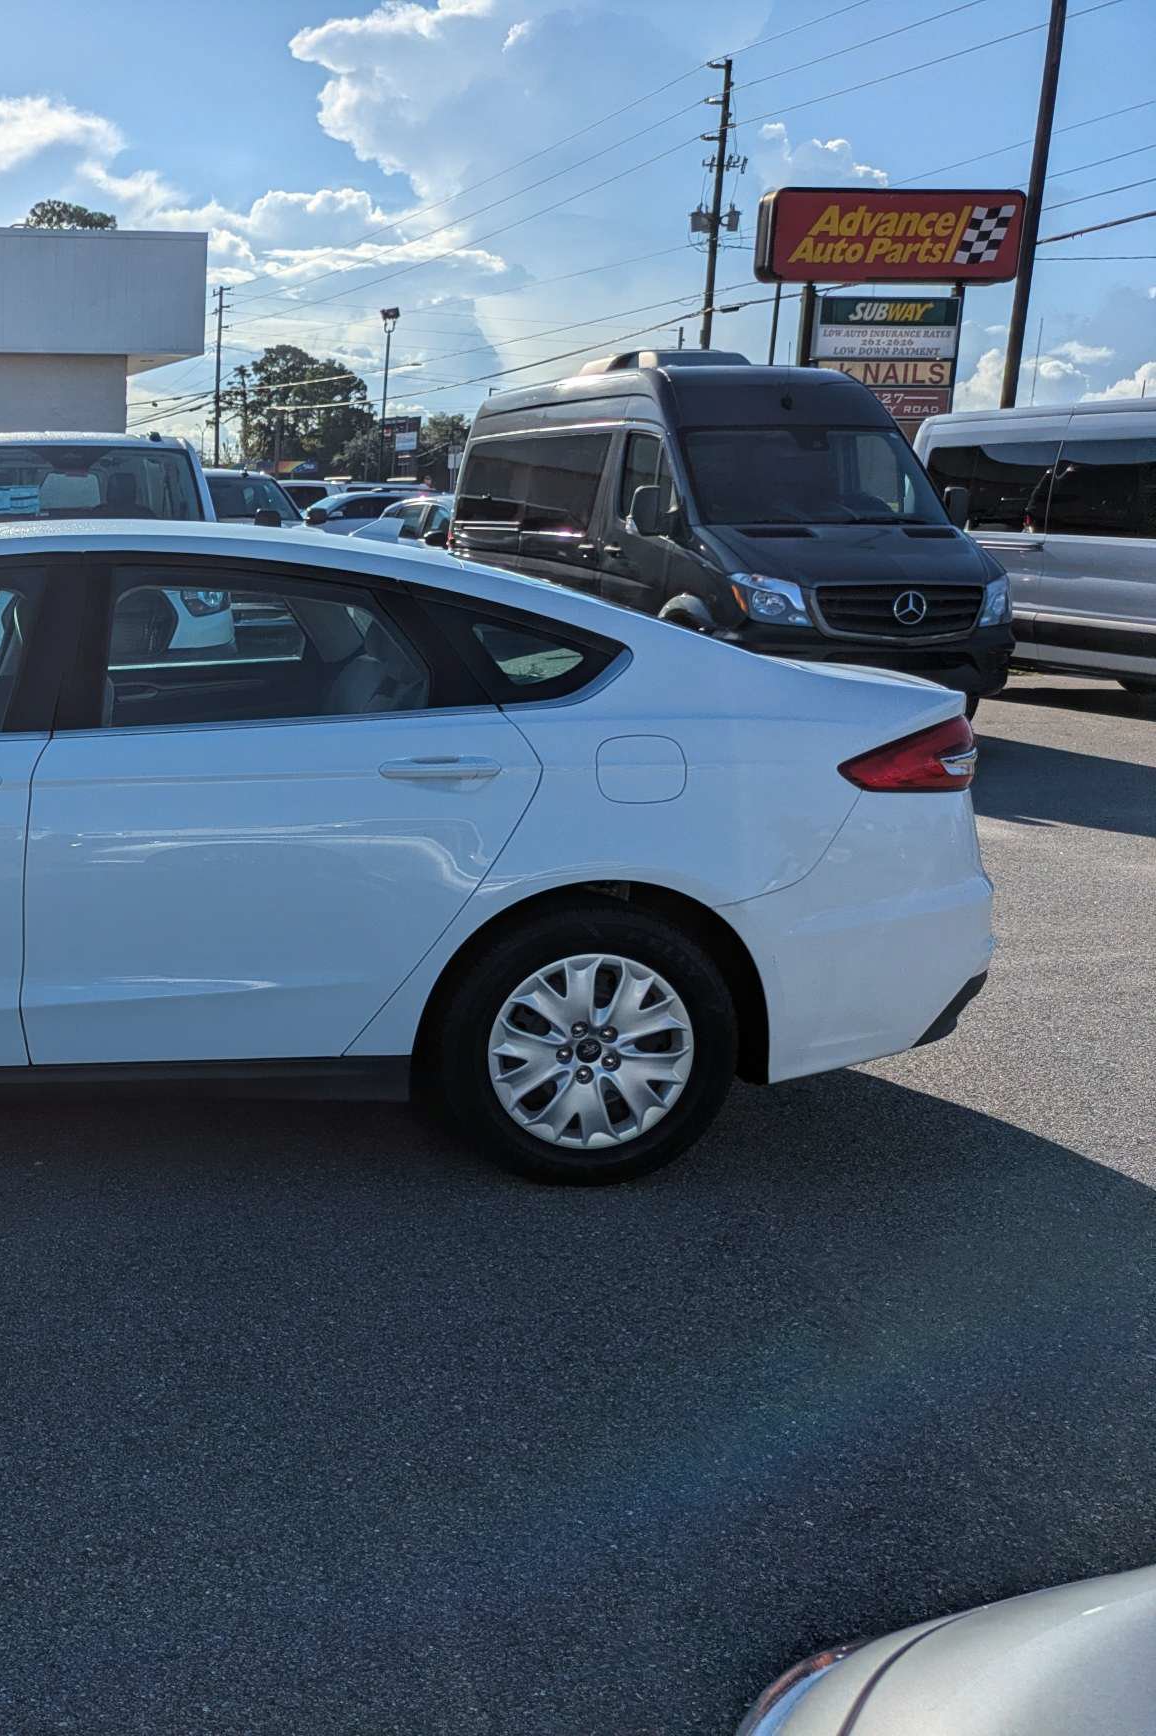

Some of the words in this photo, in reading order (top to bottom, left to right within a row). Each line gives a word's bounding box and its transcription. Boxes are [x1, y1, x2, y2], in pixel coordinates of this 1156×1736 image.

[808, 205, 956, 237] Advance
[787, 237, 865, 264] Auto
[865, 238, 946, 264] Parts
[848, 302, 934, 321] SUBWAY
[823, 329, 844, 337] LOW
[844, 329, 868, 338] AUTO
[869, 329, 921, 338] INSURANCE
[833, 347, 856, 355] LOW
[858, 347, 890, 355] DOWN
[892, 347, 941, 356] PAYMENT
[863, 363, 945, 384] NAILS
[903, 405, 940, 414] ROAD
